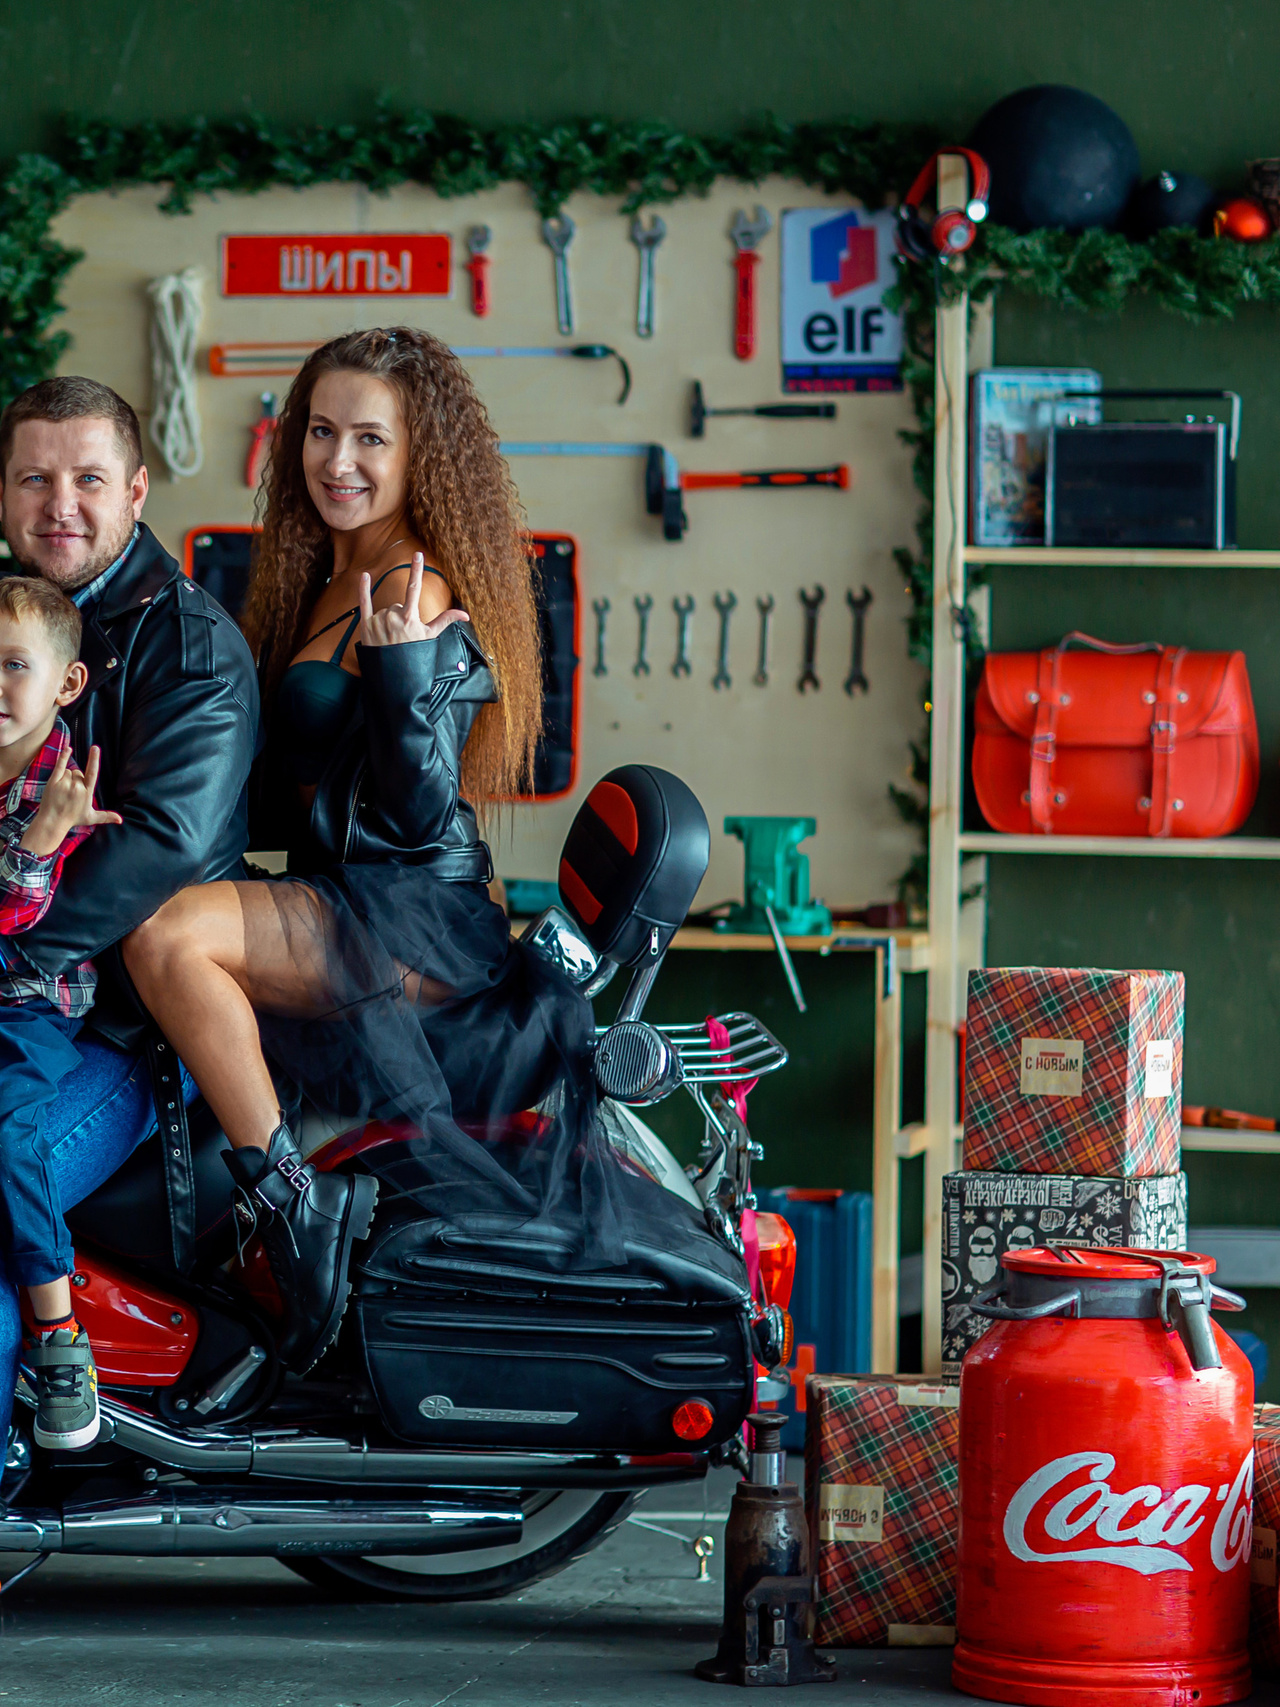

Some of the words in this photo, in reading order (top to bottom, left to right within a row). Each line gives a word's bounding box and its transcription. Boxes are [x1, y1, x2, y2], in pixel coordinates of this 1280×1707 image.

[280, 245, 412, 291] ШИПЫ
[803, 307, 883, 354] elf
[1025, 1056, 1033, 1070] С
[1035, 1057, 1079, 1072] НОВЫМ
[1003, 1446, 1254, 1575] Coca-C
